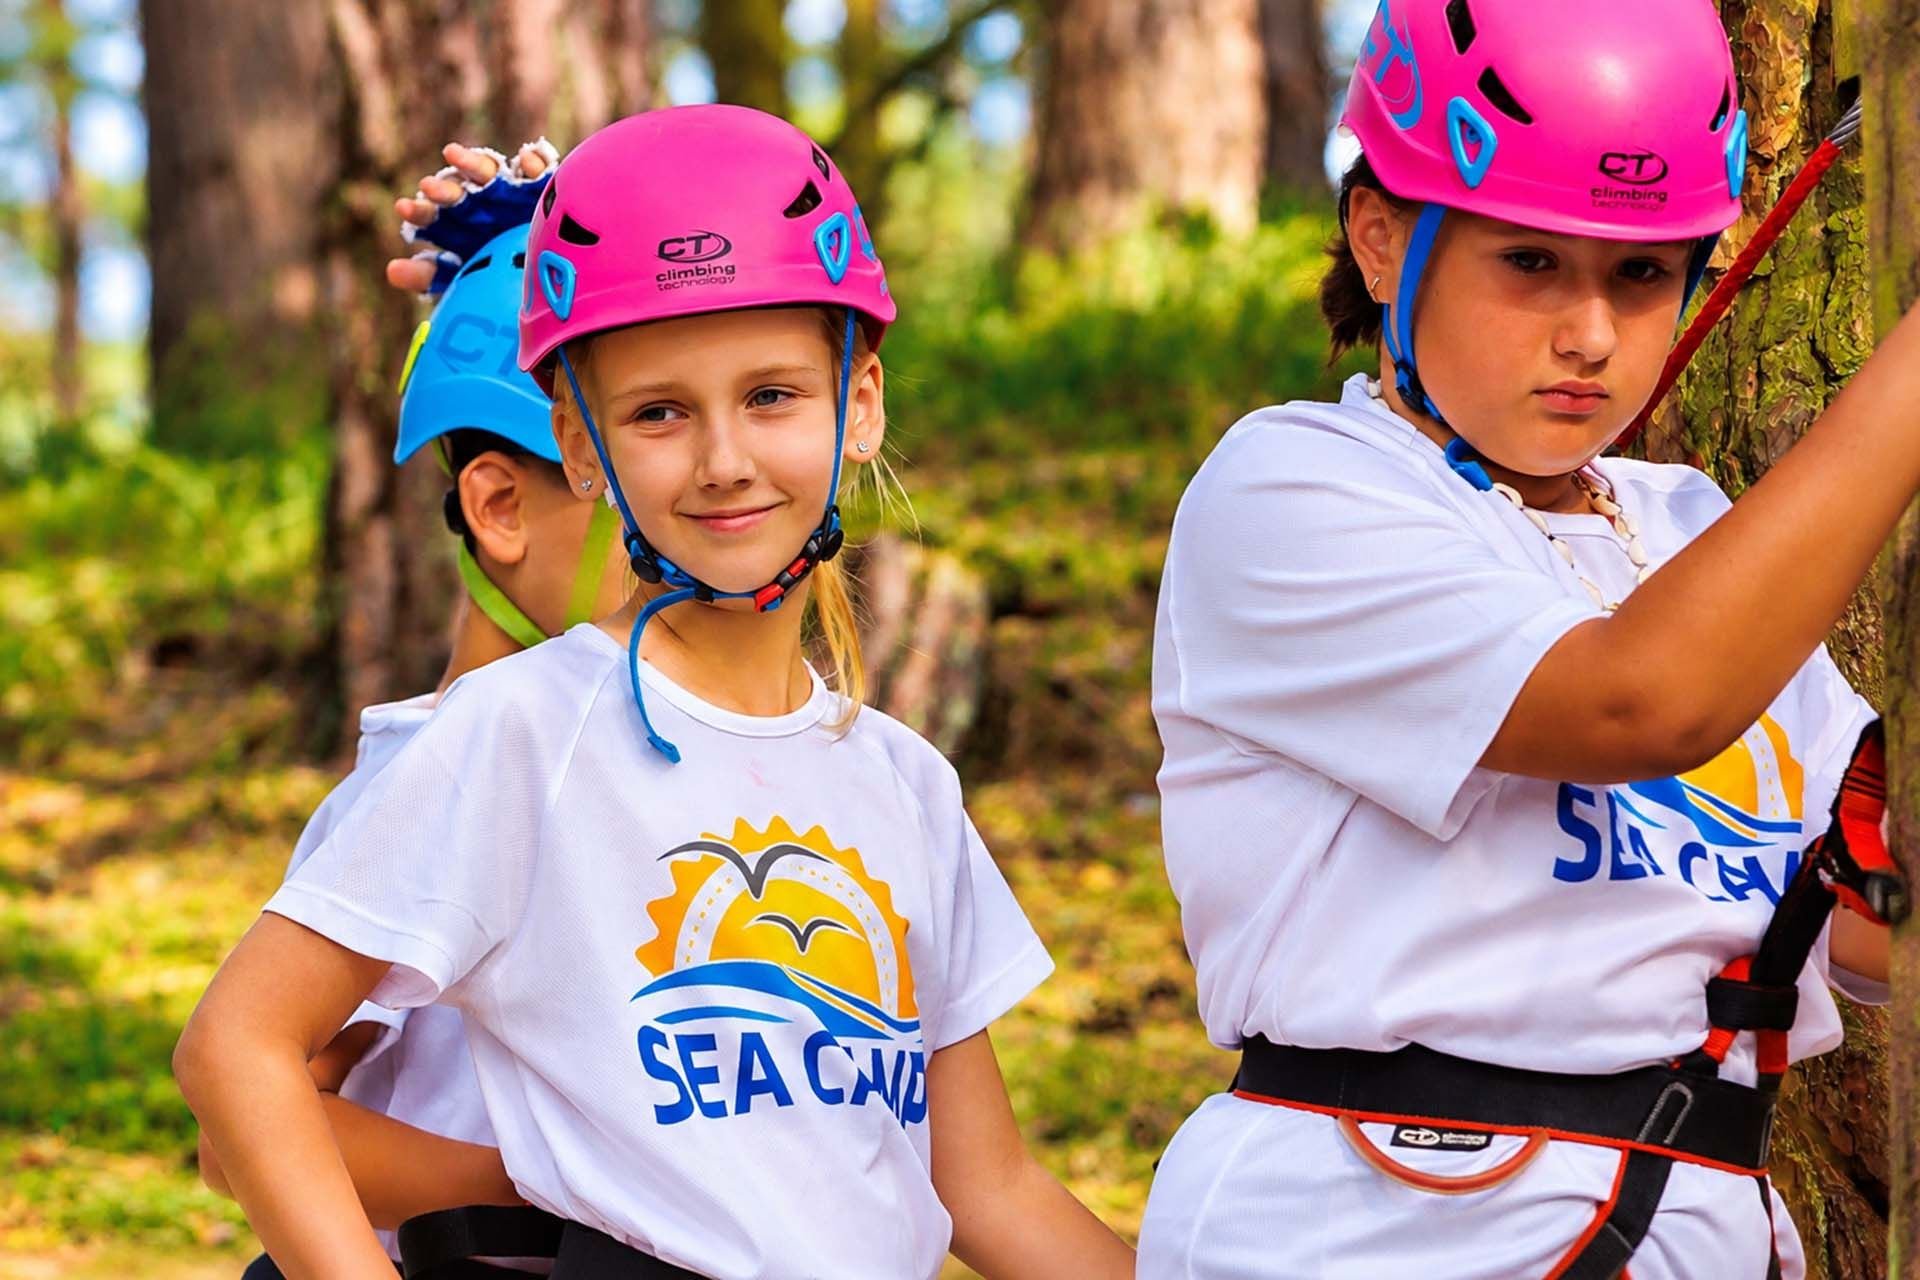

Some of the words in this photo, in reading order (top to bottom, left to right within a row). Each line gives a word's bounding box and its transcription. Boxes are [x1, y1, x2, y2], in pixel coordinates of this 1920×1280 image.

[1599, 152, 1655, 177] CT
[1591, 187, 1668, 203] climbing
[657, 234, 713, 258] CT
[656, 264, 736, 283] climbing
[657, 276, 736, 292] technology
[638, 1025, 794, 1125] SEA
